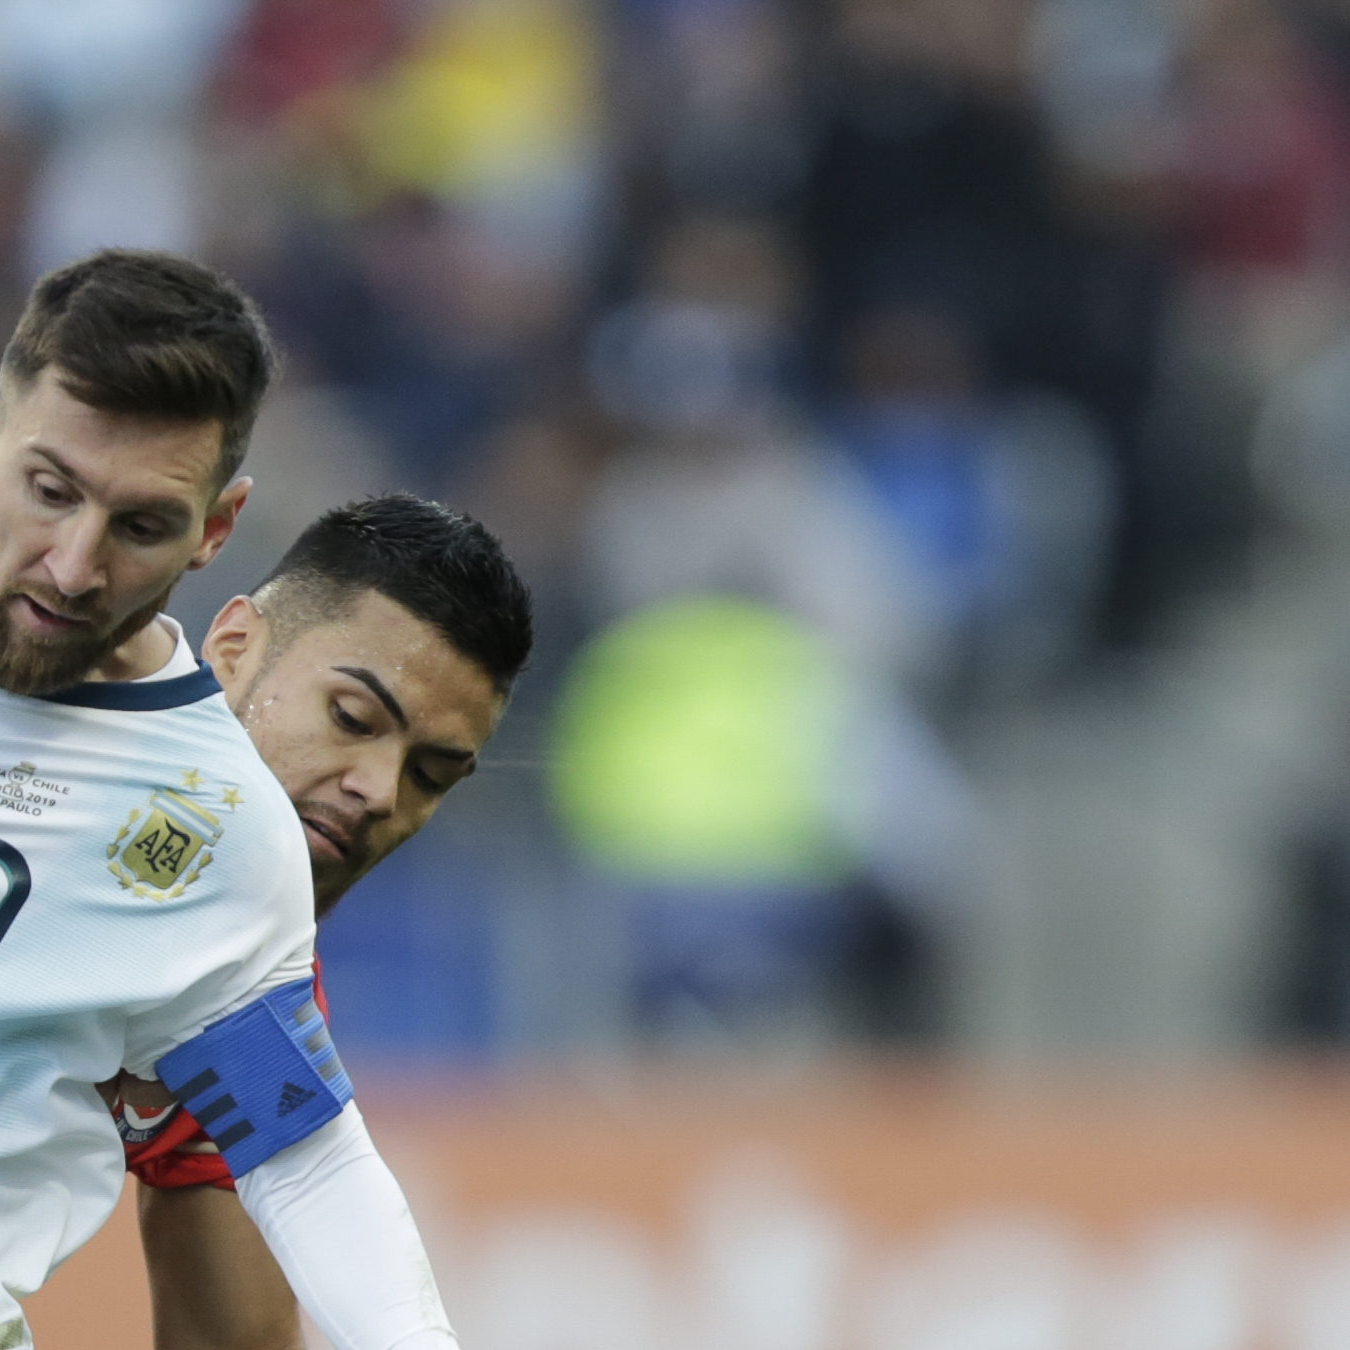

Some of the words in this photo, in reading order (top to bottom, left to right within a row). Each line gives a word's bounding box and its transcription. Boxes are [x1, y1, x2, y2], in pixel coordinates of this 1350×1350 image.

[32, 778, 71, 795] CHILE
[0, 798, 42, 816] PAULO
[25, 792, 57, 807] 2019
[135, 817, 191, 873] AFA
